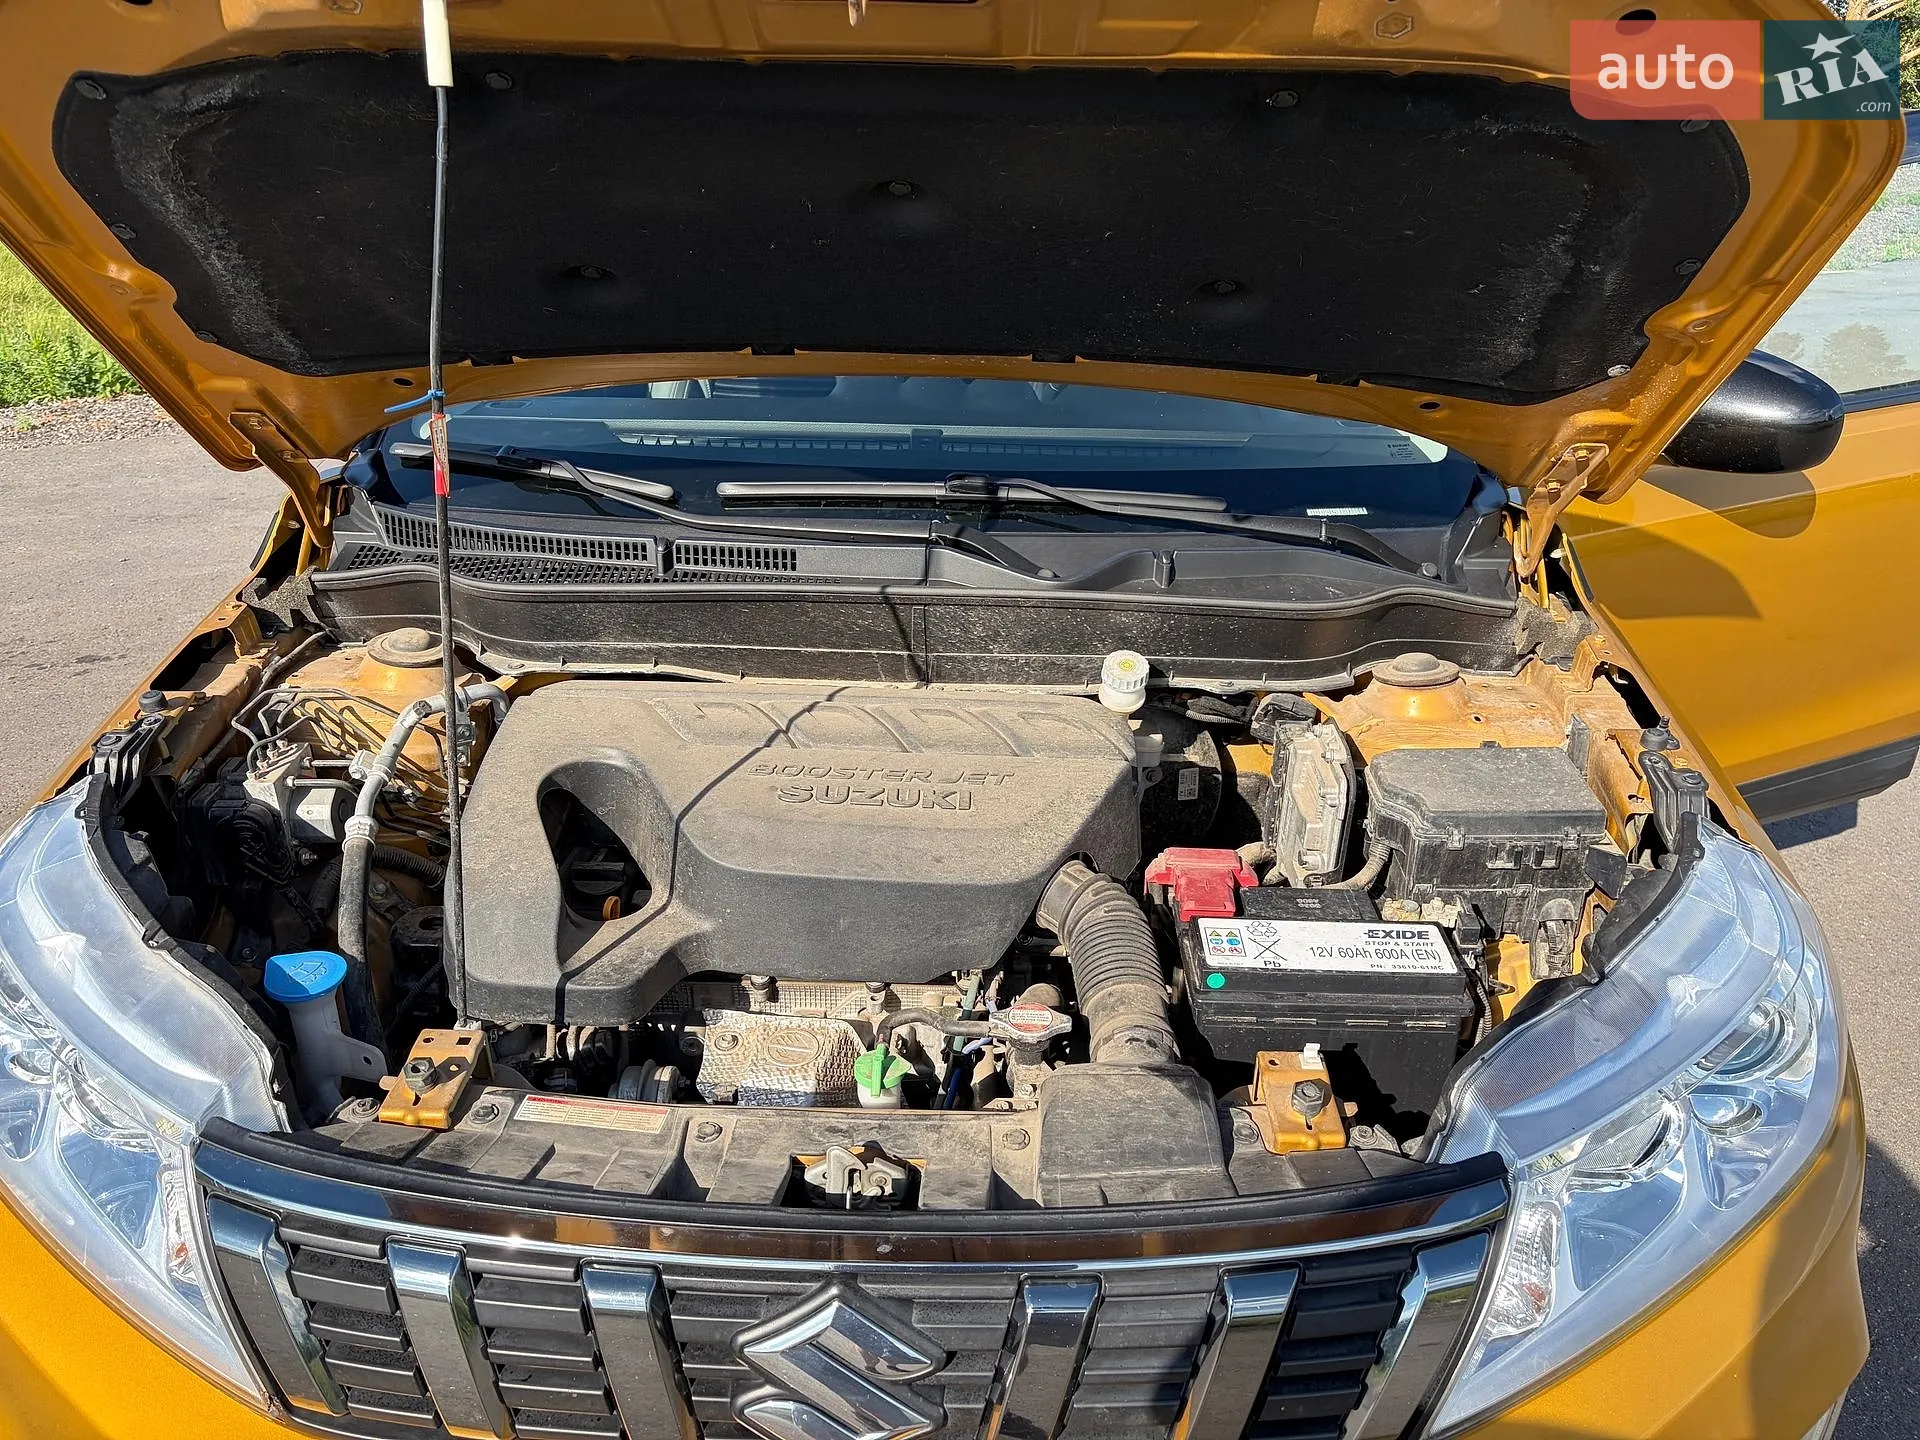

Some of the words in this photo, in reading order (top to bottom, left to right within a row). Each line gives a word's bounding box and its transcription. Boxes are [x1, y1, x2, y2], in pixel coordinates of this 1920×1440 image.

[748, 763, 1016, 786] BOOSTERJET
[777, 784, 972, 810] SUZUKI
[1364, 929, 1430, 940] EXIDE
[1309, 946, 1333, 958] 12V
[1338, 947, 1372, 960] 60Ah
[1374, 948, 1410, 960] 600A
[1411, 948, 1441, 963] (EN)
[1263, 960, 1282, 968] Pb
